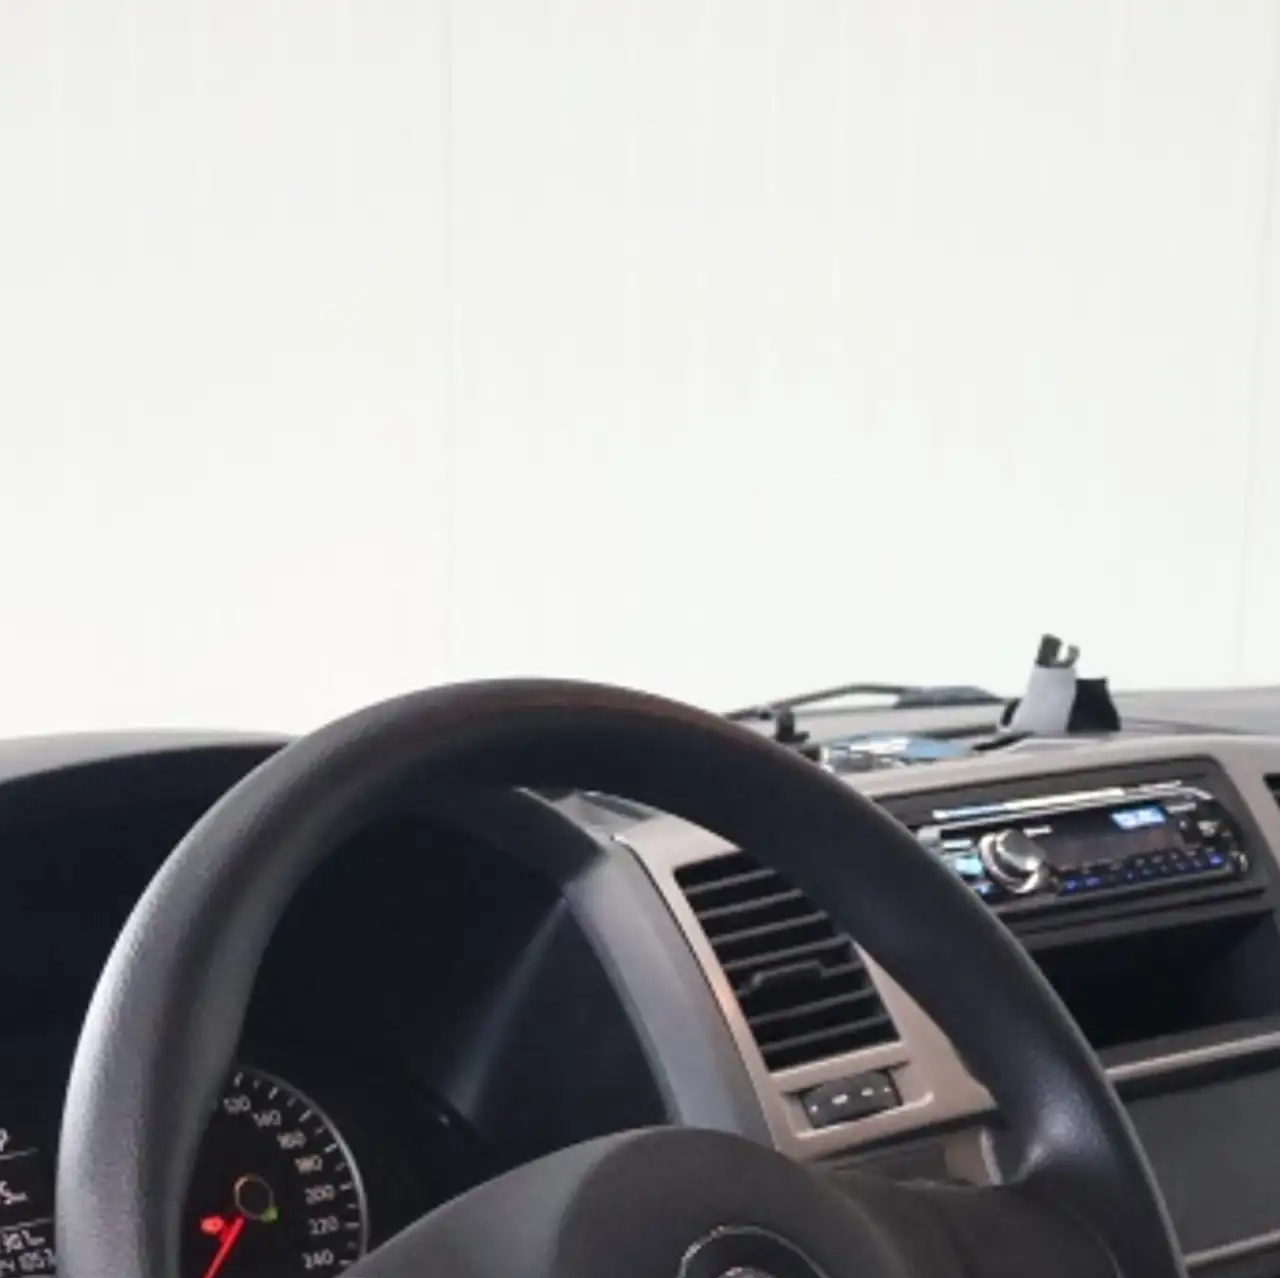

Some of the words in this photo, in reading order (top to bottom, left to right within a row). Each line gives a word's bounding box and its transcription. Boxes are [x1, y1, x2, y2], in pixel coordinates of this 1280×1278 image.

[304, 1183, 337, 1205] 200
[308, 1215, 341, 1236] 220
[302, 1249, 335, 1270] 240
